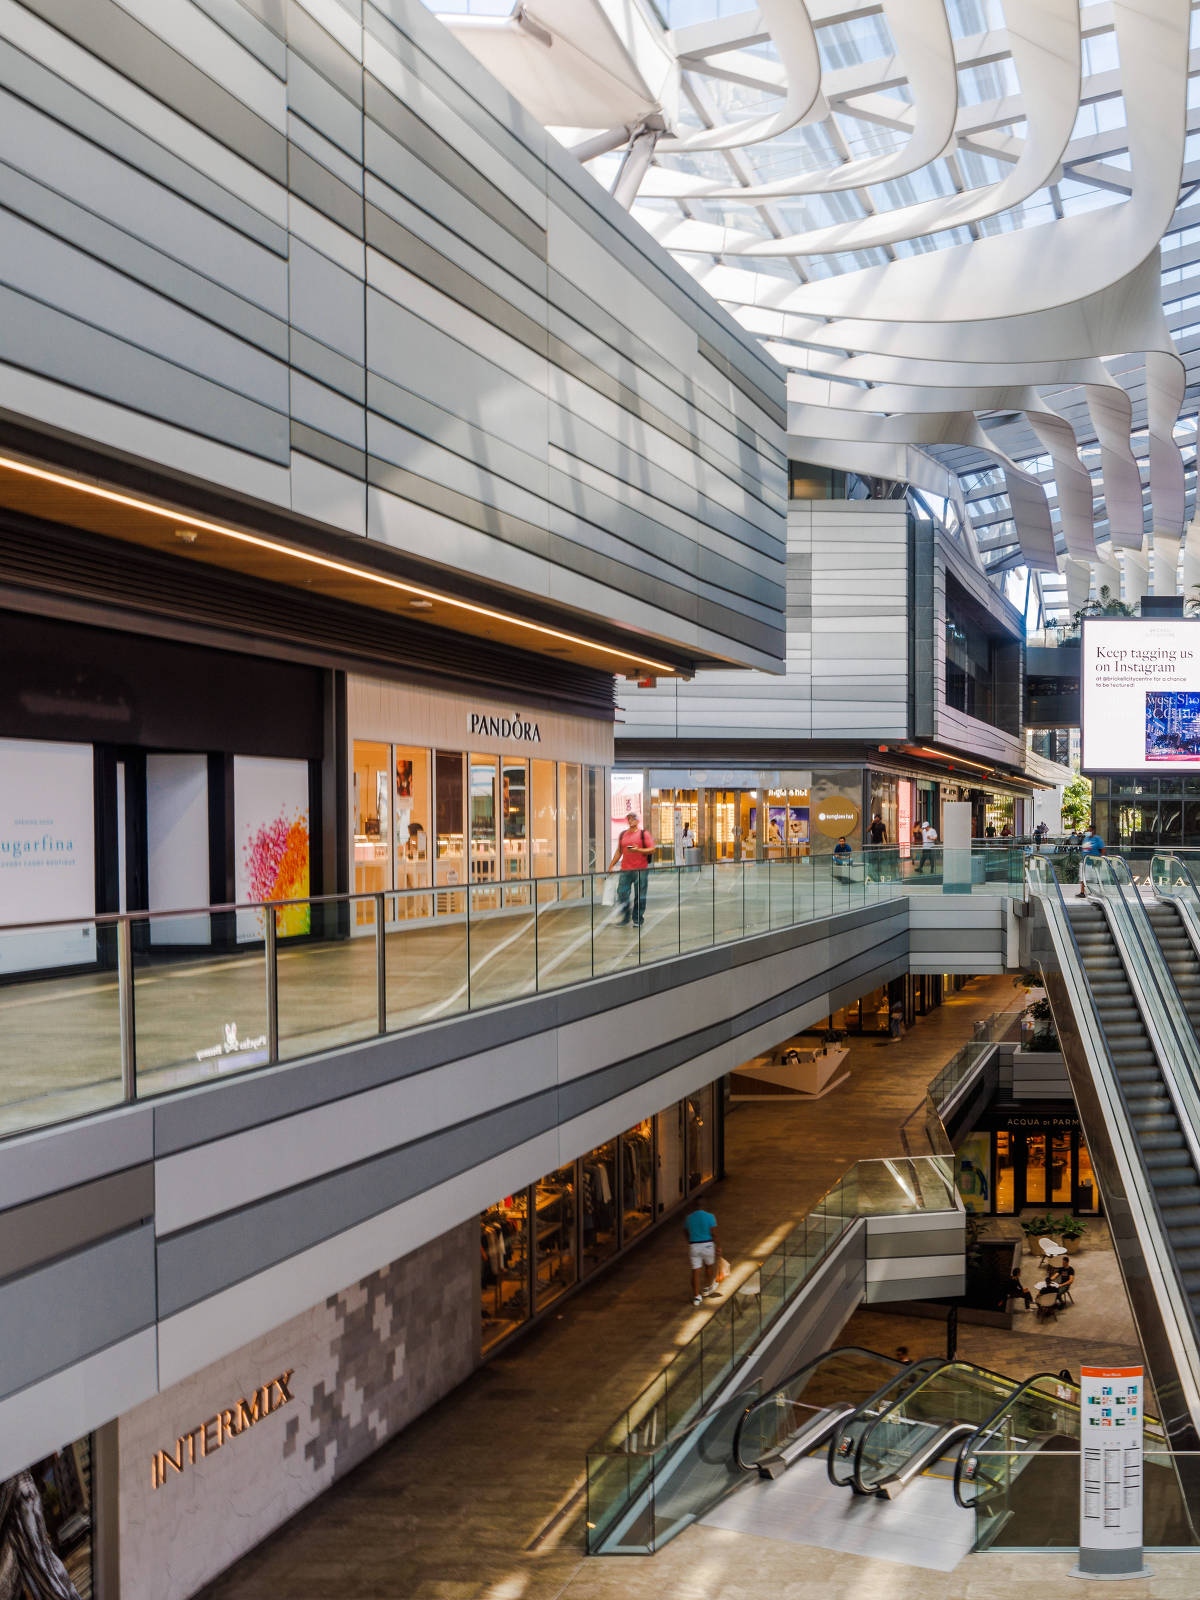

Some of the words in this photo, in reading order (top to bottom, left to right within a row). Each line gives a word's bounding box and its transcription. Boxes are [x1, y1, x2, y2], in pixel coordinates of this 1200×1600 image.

[1096, 646, 1128, 661] Keep
[1131, 647, 1177, 662] tagging
[1180, 649, 1194, 659] us
[1095, 663, 1110, 672] on
[1115, 660, 1176, 675] Instagram
[471, 713, 541, 742] PANDORA
[1, 833, 73, 858] ugarfina
[1128, 875, 1188, 887] ZARA
[1007, 1118, 1040, 1126] ACQUA
[1052, 1118, 1079, 1126] PARM
[151, 1367, 296, 1490] INTERMIX
